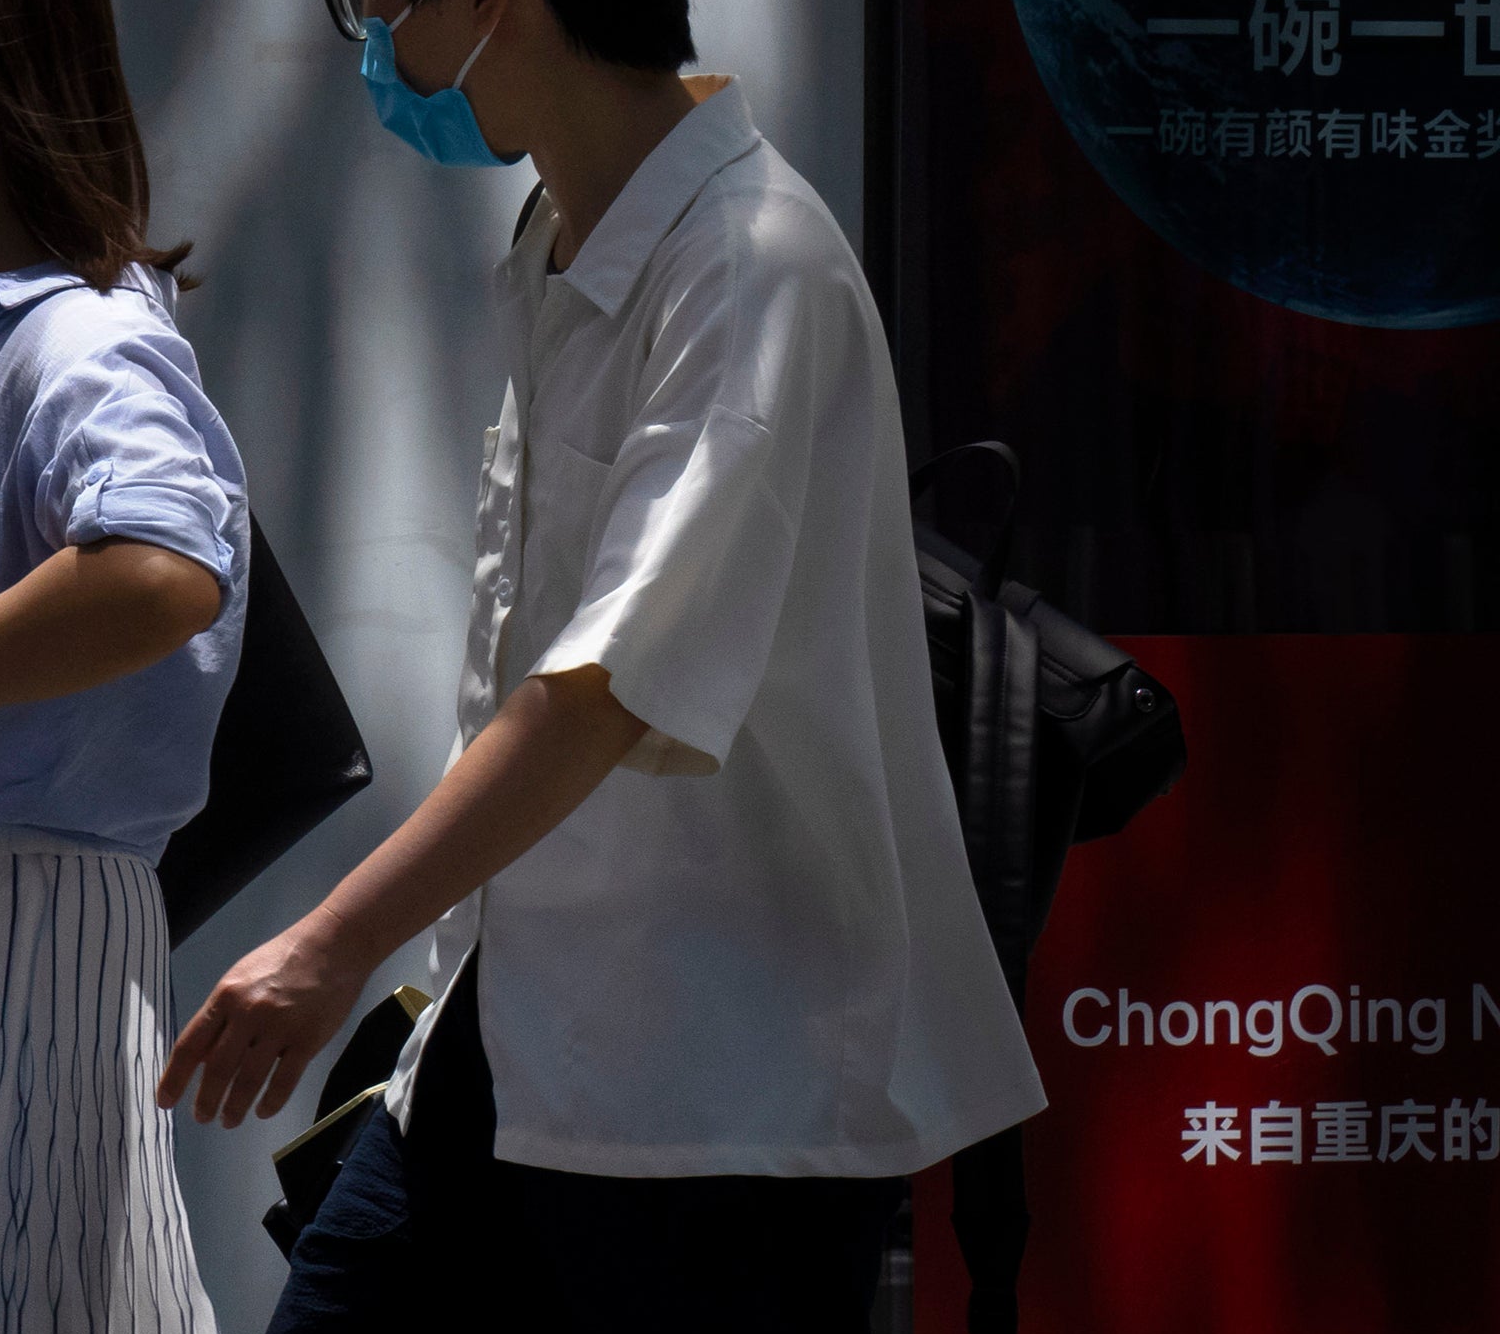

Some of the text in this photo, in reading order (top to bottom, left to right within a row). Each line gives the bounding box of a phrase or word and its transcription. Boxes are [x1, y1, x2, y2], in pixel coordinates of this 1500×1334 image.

[1062, 983, 1446, 1057] ChongQing
[1181, 1096, 1500, 1166] 来自重庆的
